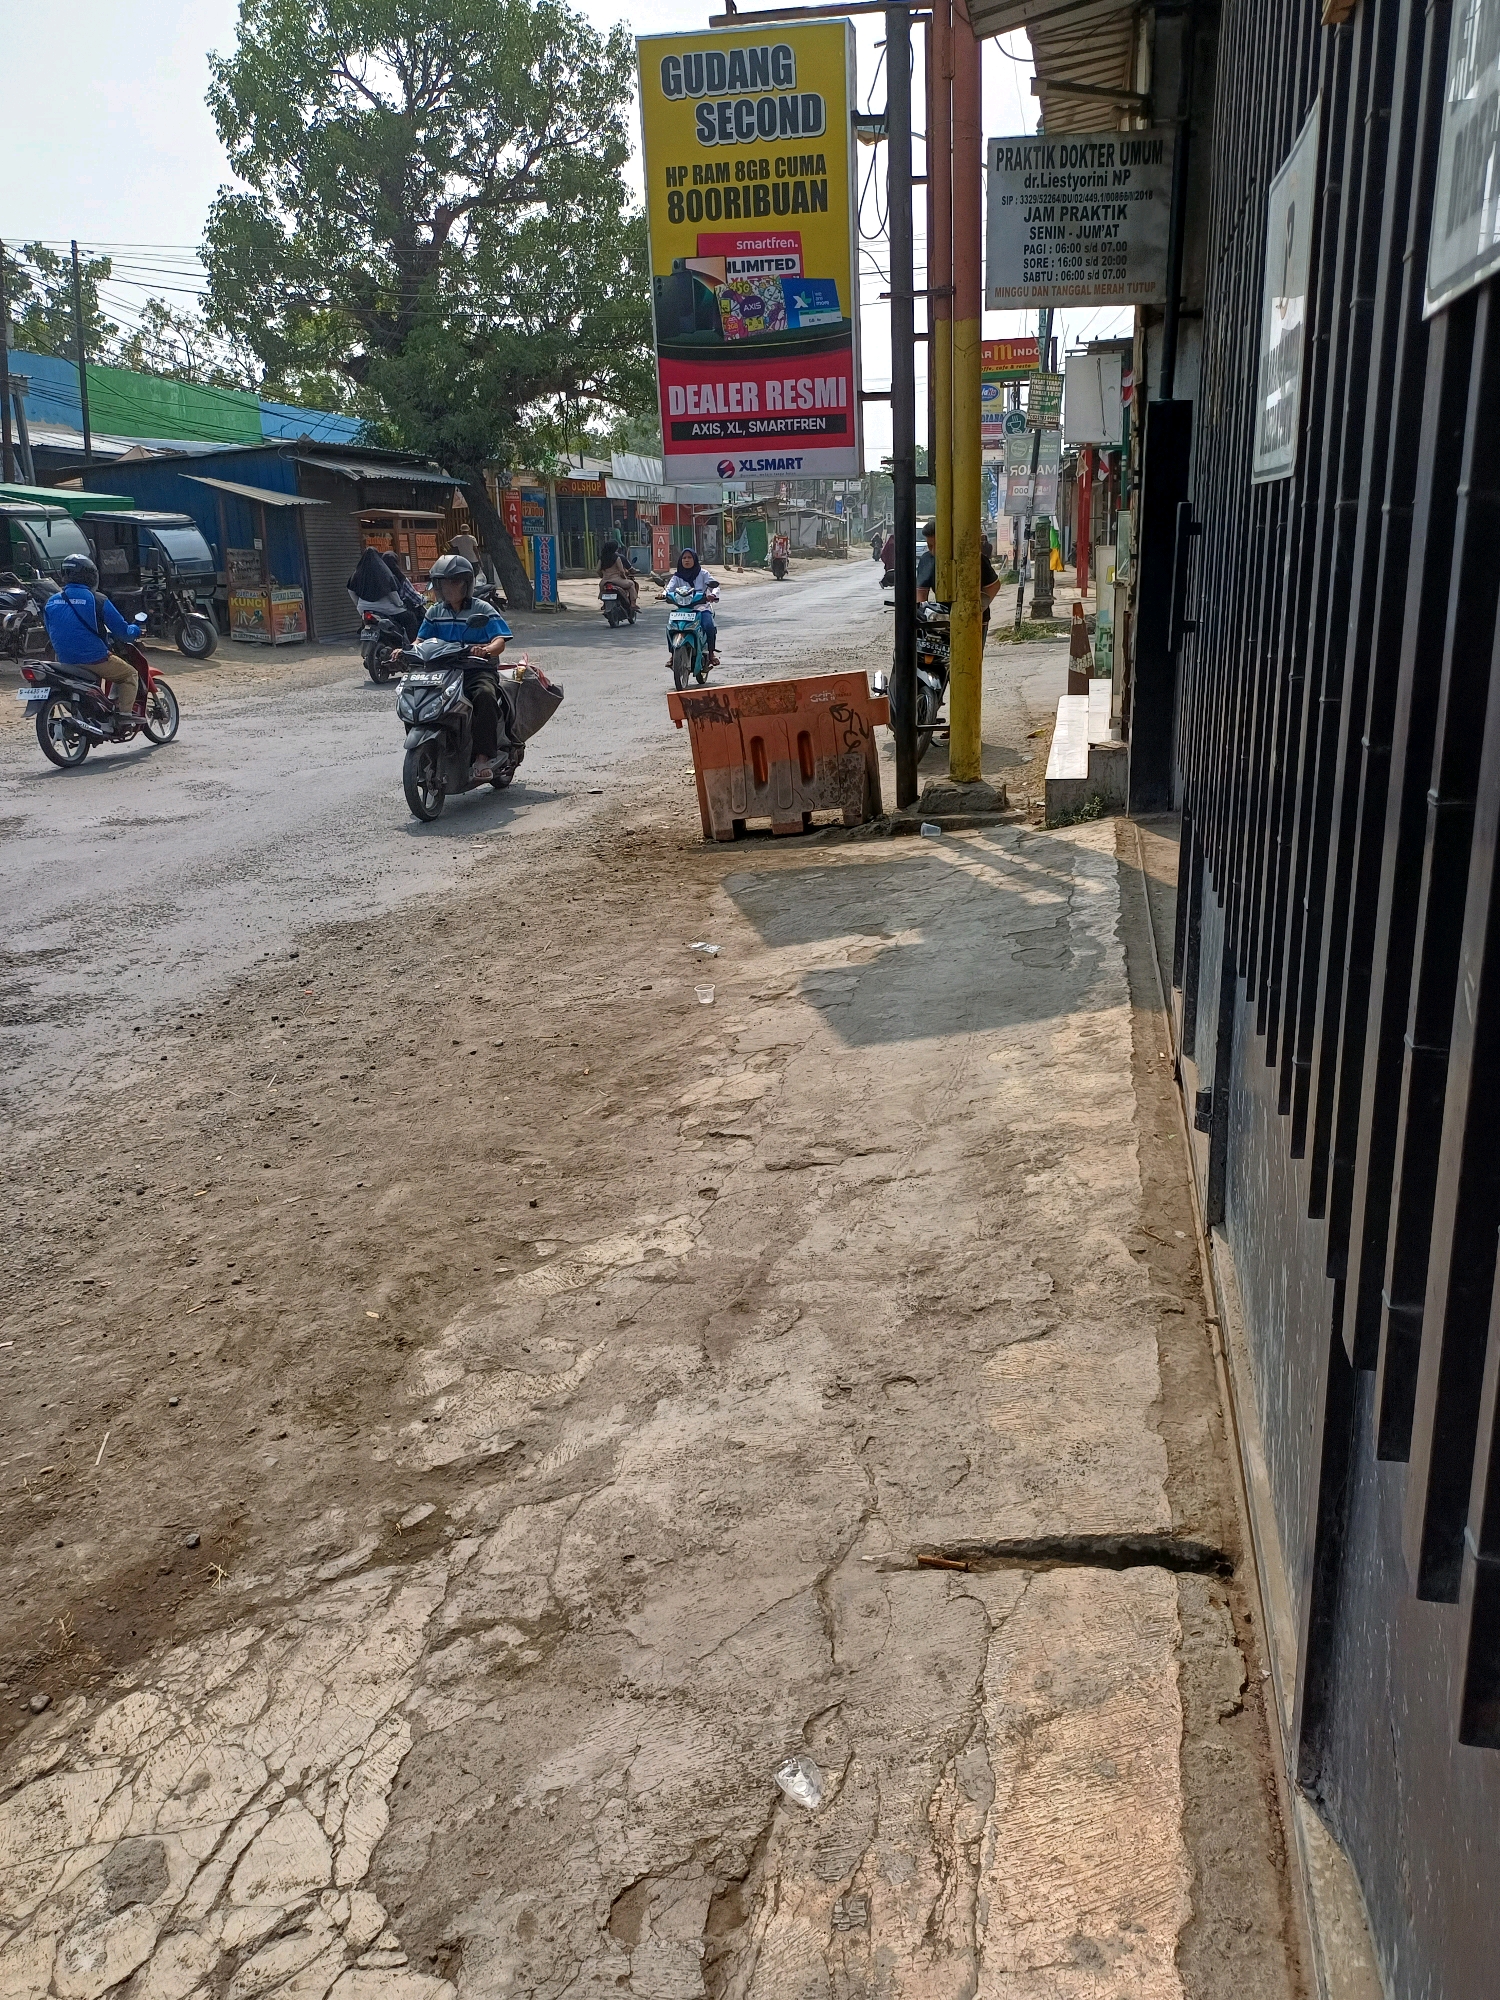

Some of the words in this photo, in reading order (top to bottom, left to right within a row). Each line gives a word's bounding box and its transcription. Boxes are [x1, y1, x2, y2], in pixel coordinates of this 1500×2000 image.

[661, 44, 795, 98] GUDANG
[695, 94, 825, 145] SECOND
[996, 144, 1056, 171] PRAKTIK
[1060, 143, 1115, 169] DOKTER
[1119, 140, 1164, 166] UMUM
[666, 166, 687, 187] HP
[693, 162, 730, 185] RAM
[735, 159, 770, 182] 8GB
[775, 154, 826, 178] CUMA
[1024, 171, 1108, 192] dr.Liestyorini
[1112, 169, 1131, 186] NP
[1001, 196, 1014, 206] SIP
[1024, 206, 1055, 223] JAM
[1059, 204, 1128, 222] PRAKTIK
[1029, 226, 1066, 241] SENIN
[1075, 224, 1119, 239] JUM'AT
[1023, 244, 1046, 255] PAGI
[1055, 242, 1082, 254] 06:00
[1084, 241, 1098, 253] s/d
[1023, 257, 1049, 269] SORE
[1057, 256, 1083, 268] 16:00
[1085, 255, 1098, 267] s/d
[1101, 255, 1128, 266] 20:00
[1022, 271, 1053, 283] SABTU
[1060, 270, 1085, 282] 06:00
[1087, 269, 1100, 280] s/d
[994, 286, 1029, 298] MINGGU
[1031, 285, 1049, 297] DAN
[1051, 284, 1092, 296] TANGGAL
[1093, 283, 1125, 295] MERAH
[1127, 282, 1156, 294] TUTUP
[743, 301, 762, 312] AXIS
[668, 381, 759, 416] DEALER
[766, 376, 847, 411] RESMI
[691, 422, 725, 437] AXIS,
[727, 421, 746, 435] XL,
[748, 417, 826, 433] SMARTFREN
[739, 458, 803, 472] XLSMART
[572, 482, 601, 492] OLSHOP
[657, 535, 665, 569] AKI
[230, 598, 266, 608] KUNCI
